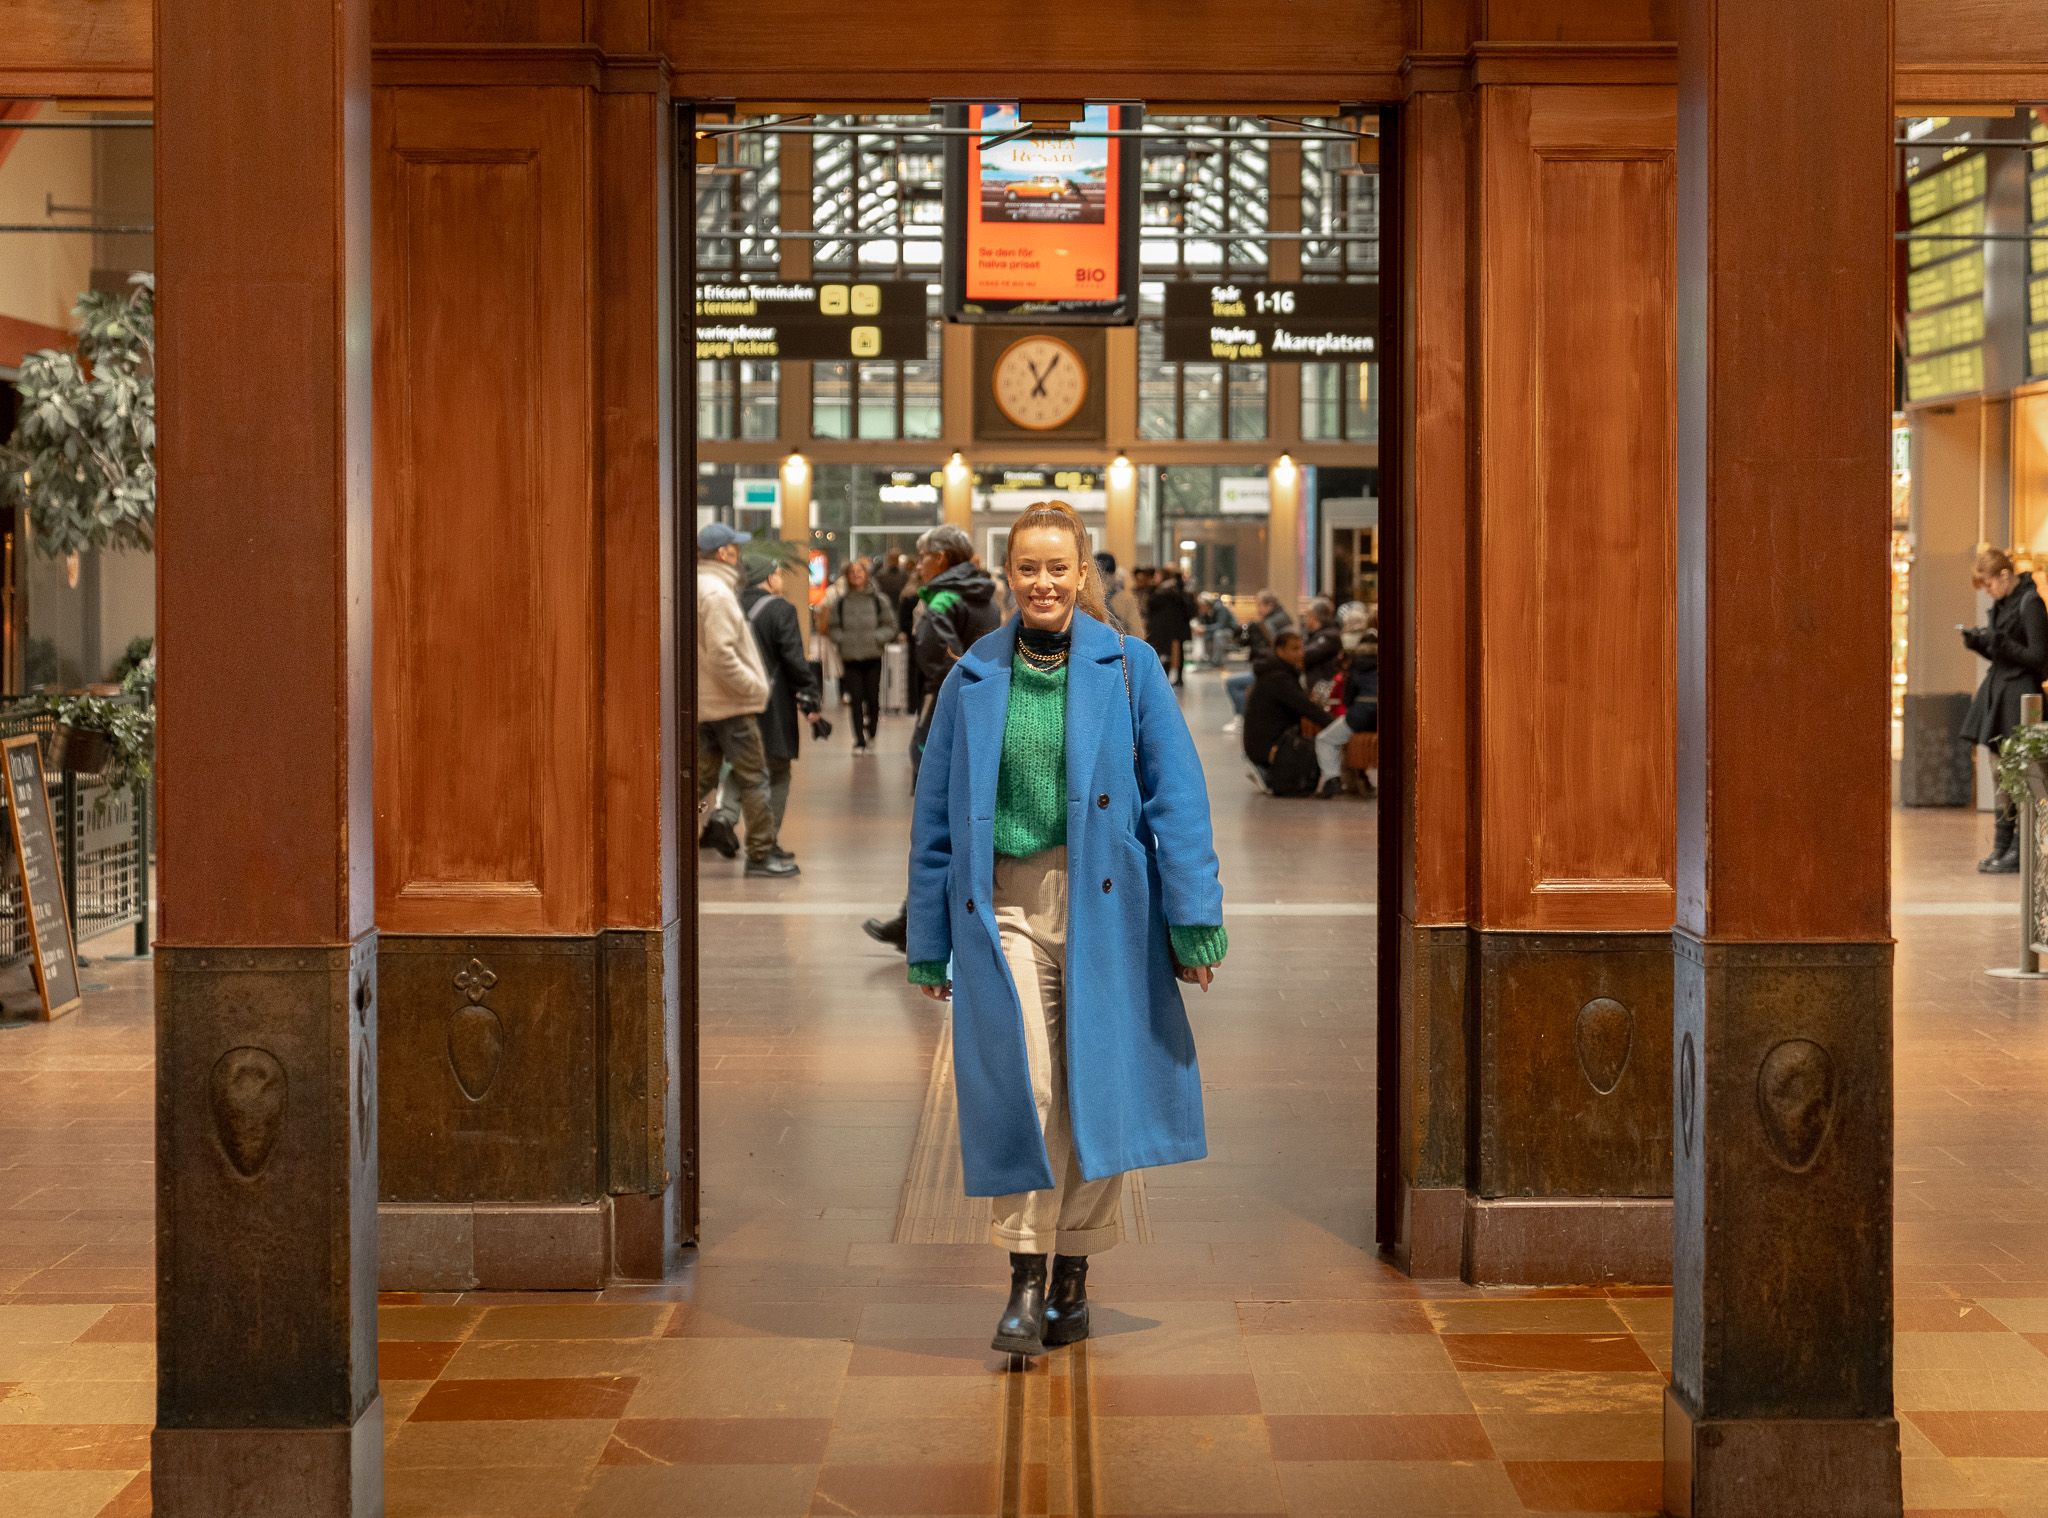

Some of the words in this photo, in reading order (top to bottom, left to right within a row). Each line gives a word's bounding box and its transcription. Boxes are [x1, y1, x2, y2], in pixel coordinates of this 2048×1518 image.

[995, 247, 1016, 257] den
[1018, 246, 1033, 257] för
[979, 259, 1007, 269] halva
[1009, 259, 1041, 271] priset
[704, 285, 749, 300] Ericson
[748, 285, 816, 301] Terminalen
[1211, 285, 1242, 303] Spår
[1254, 290, 1296, 315] 1-16
[704, 299, 757, 316] terminal
[1212, 300, 1247, 317] Track
[733, 340, 779, 356] lockers
[1211, 326, 1257, 344] Utgång
[1272, 328, 1374, 356] Åkareplatsen
[1211, 343, 1238, 360] Way
[1239, 343, 1263, 358] out
